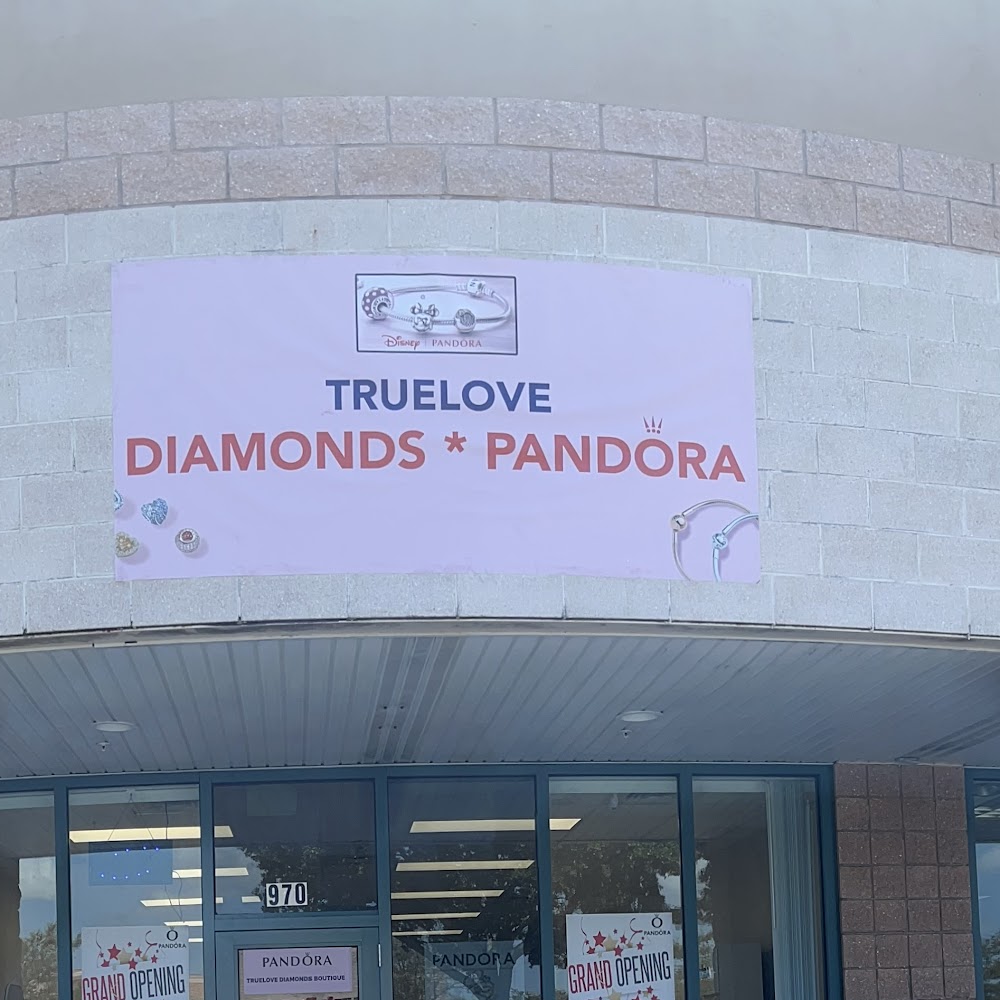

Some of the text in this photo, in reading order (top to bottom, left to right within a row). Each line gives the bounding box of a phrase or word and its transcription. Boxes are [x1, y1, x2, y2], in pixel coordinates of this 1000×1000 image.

[432, 339, 482, 348] PANDORA
[325, 379, 552, 413] TRUELOVE
[126, 430, 746, 483] DIAMONDS PANDORA
[267, 883, 307, 906] 970
[262, 954, 332, 967] PANDORA
[568, 951, 672, 994] GRAND OPENING
[129, 964, 186, 1000] OPENING
